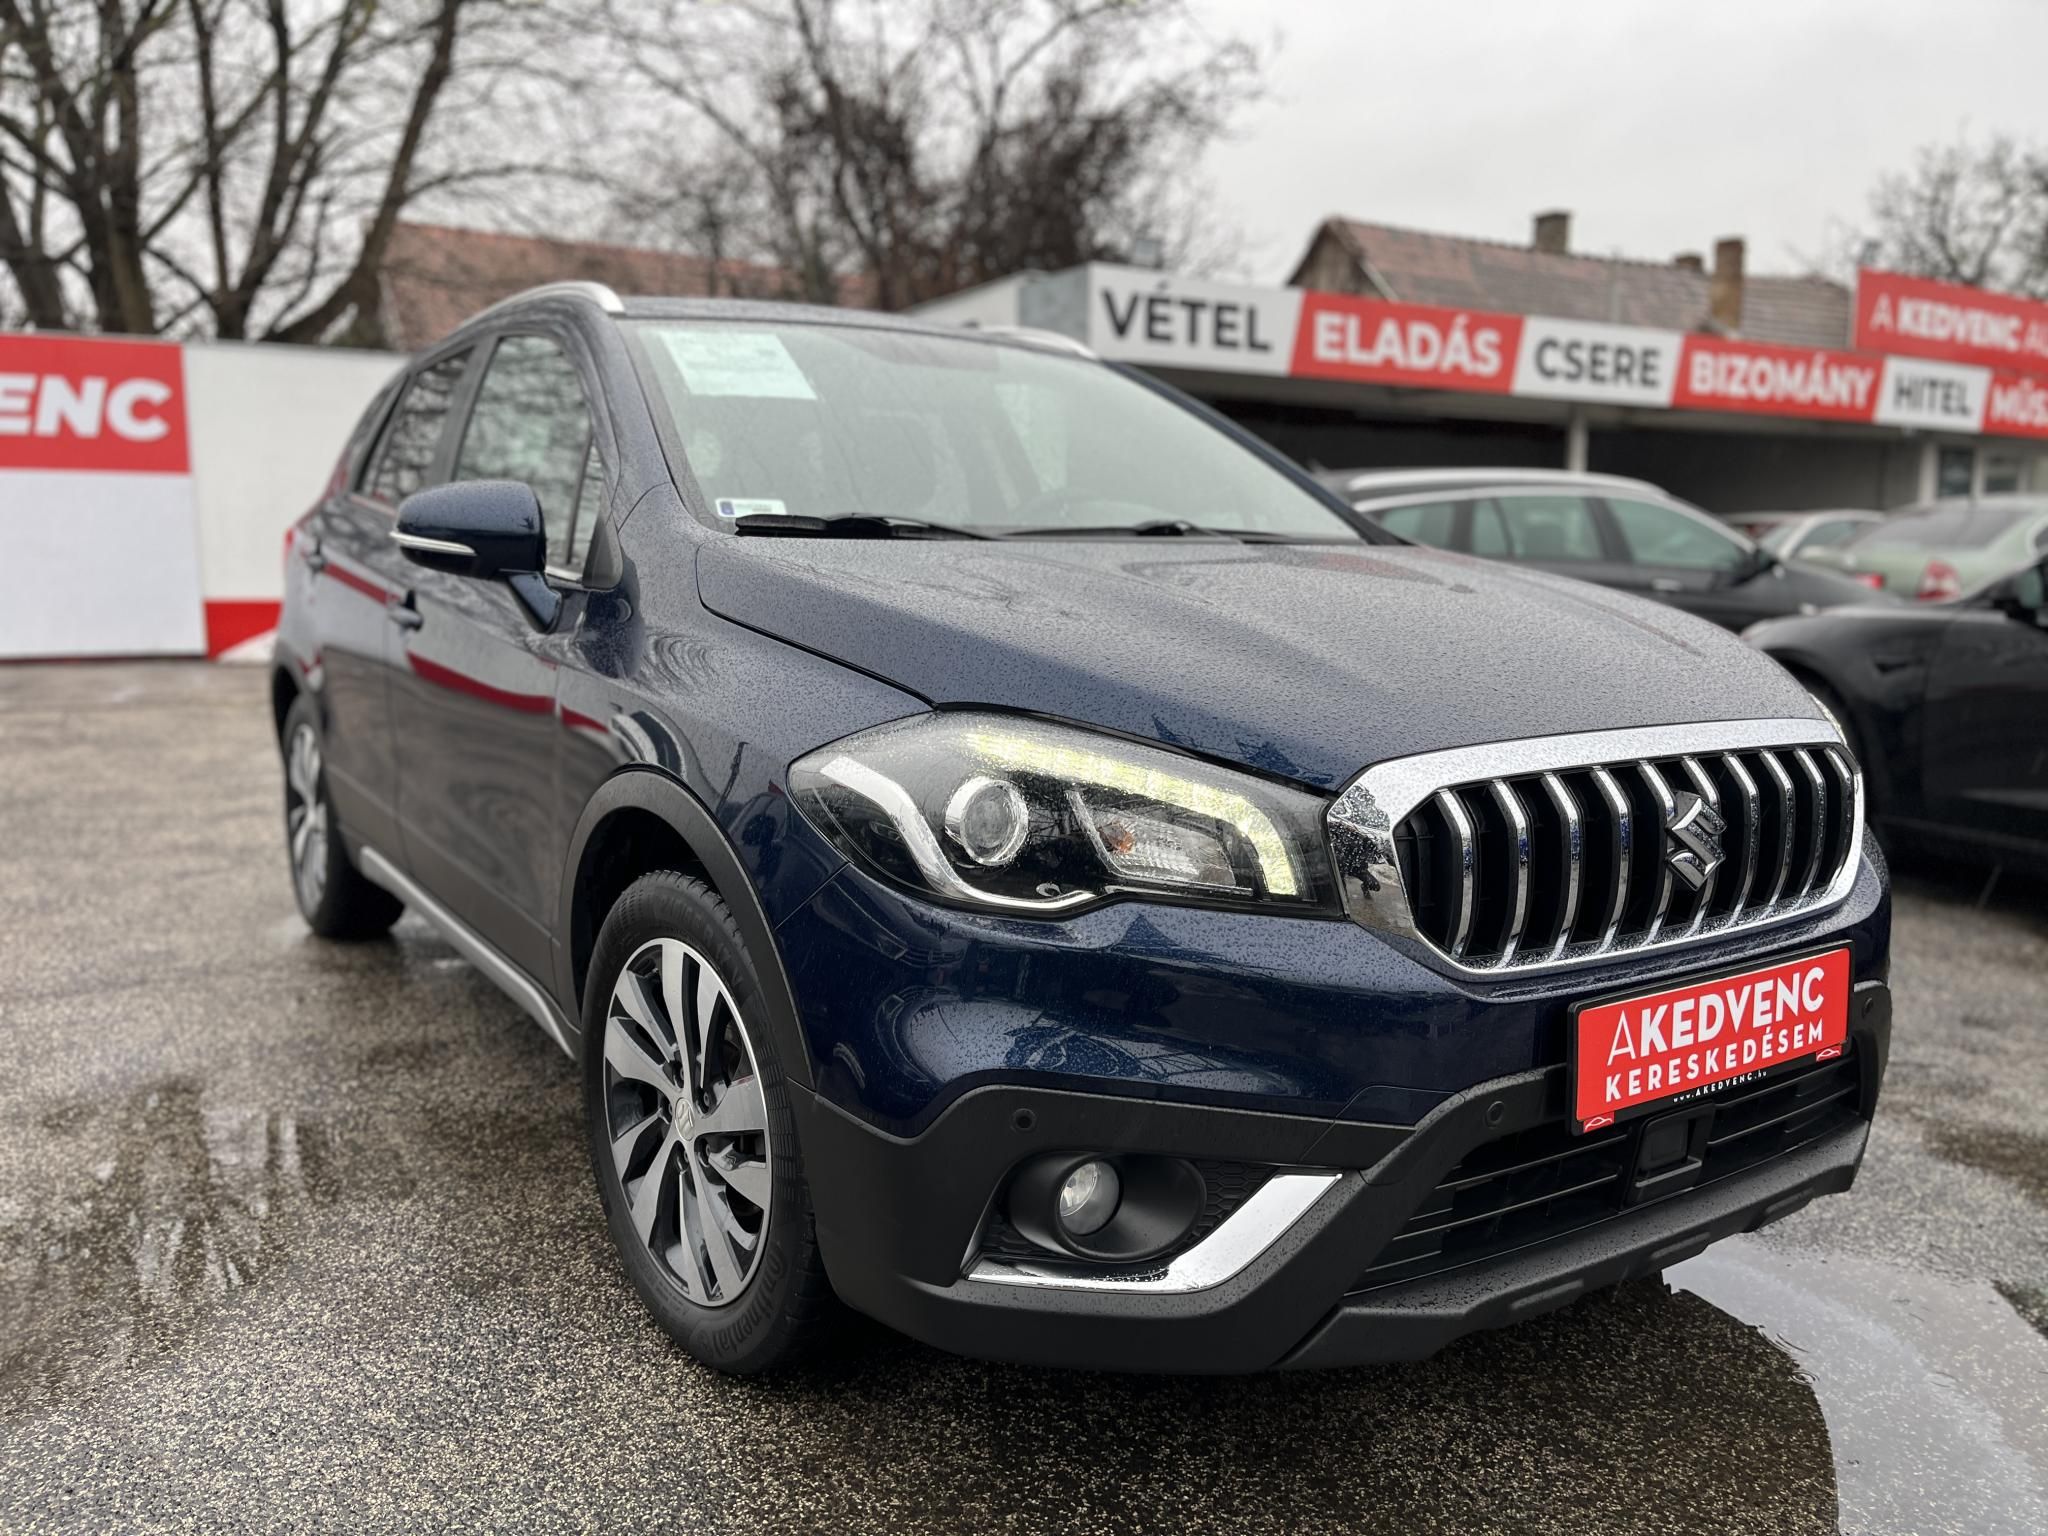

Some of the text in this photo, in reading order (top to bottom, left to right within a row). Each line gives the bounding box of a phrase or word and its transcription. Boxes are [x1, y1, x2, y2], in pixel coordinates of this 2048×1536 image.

[1101, 281, 1272, 353] VÉTEL
[1313, 310, 1502, 377] ELADÁS
[1534, 336, 1661, 388] CSERE
[1689, 351, 1875, 408] BIZOMÁNY
[1894, 374, 1971, 416] HITEL
[1870, 293, 1894, 332] A
[1897, 297, 2022, 351] KEDVENC
[0, 371, 173, 442] ENC
[1605, 1017, 1823, 1103] KERESKEDÉSEM
[1673, 1069, 1767, 1103] www.AKEDVENC.hu
